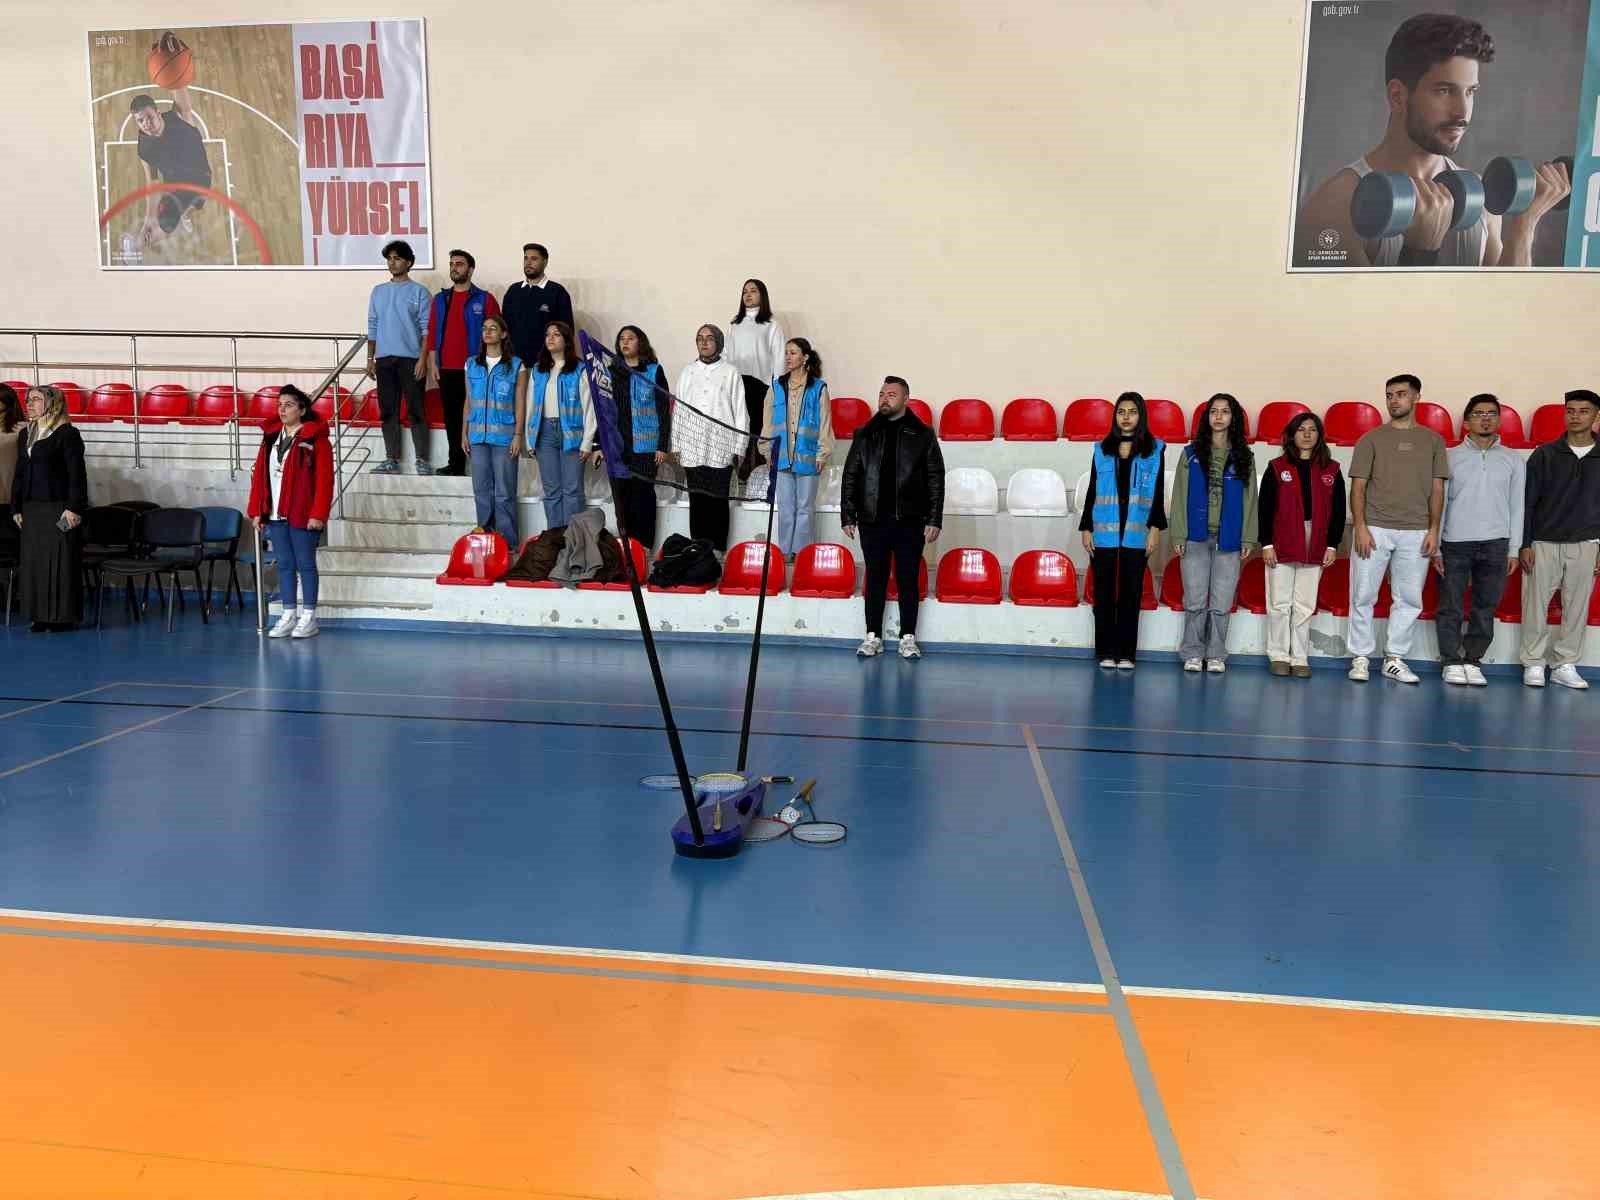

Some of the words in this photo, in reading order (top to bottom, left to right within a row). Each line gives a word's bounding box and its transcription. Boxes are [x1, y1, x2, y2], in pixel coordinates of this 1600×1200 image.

[301, 43, 384, 106] BAŞA
[303, 112, 374, 169] RIYA
[304, 175, 428, 236] YÜKSEL
